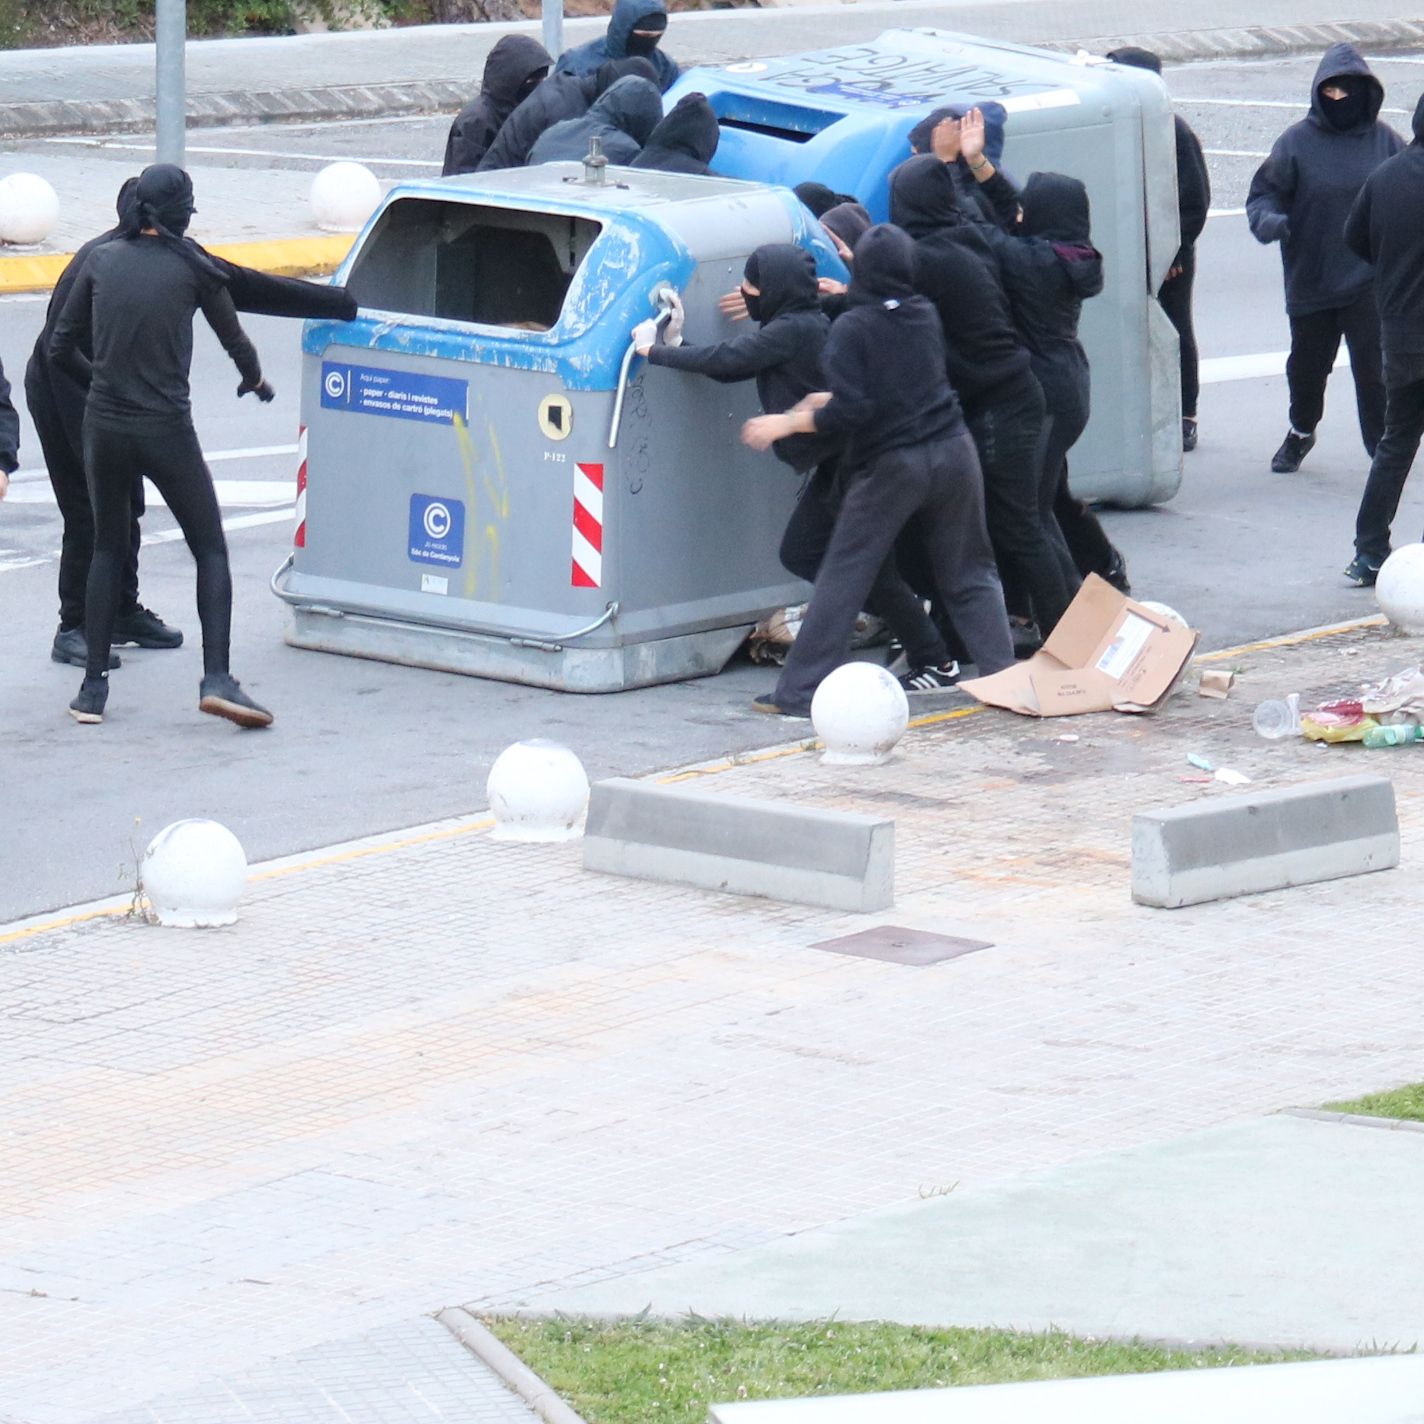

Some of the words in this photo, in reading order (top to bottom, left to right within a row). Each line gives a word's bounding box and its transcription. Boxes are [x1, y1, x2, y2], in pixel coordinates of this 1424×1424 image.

[363, 388, 384, 398] paper
[411, 394, 438, 405] revistes
[363, 399, 391, 410] envasos
